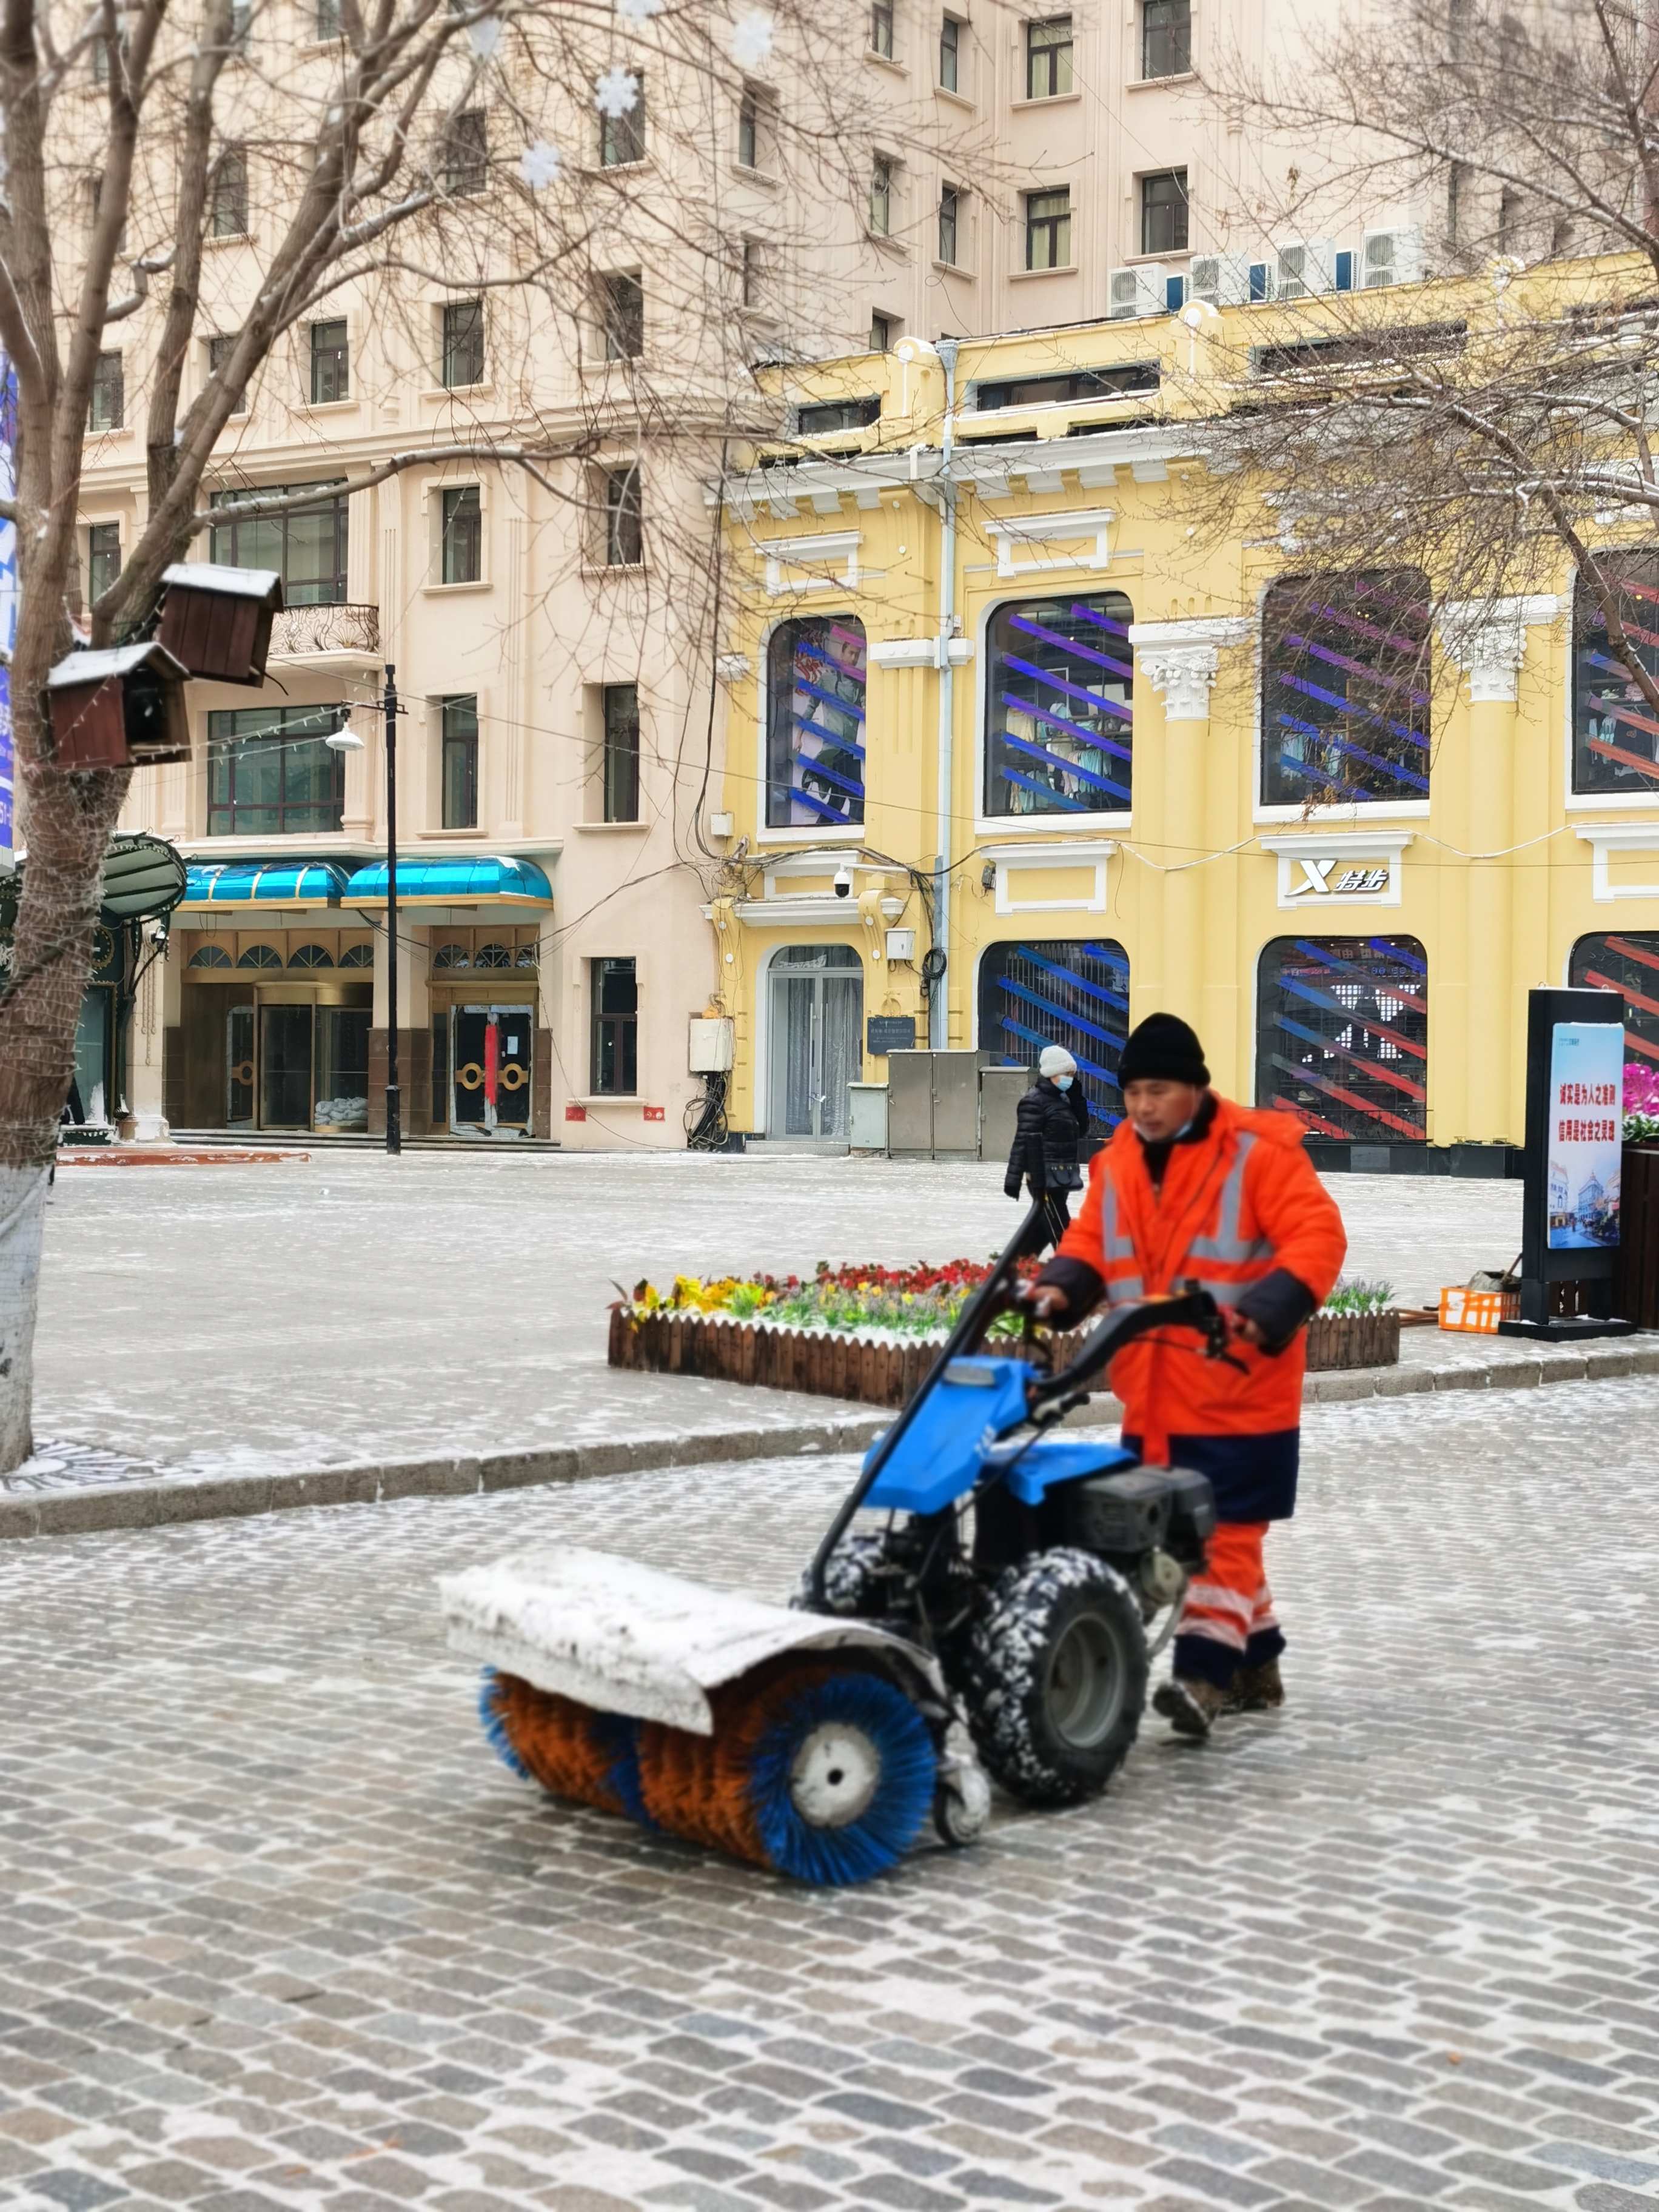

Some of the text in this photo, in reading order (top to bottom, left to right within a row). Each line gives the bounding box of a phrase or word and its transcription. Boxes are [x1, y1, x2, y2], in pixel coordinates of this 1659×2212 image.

[1332, 868, 1389, 891] 特步
[1560, 1082, 1616, 1106] 诚实是为人之准则
[1558, 1119, 1615, 1142] 信用是社会之灵魂
